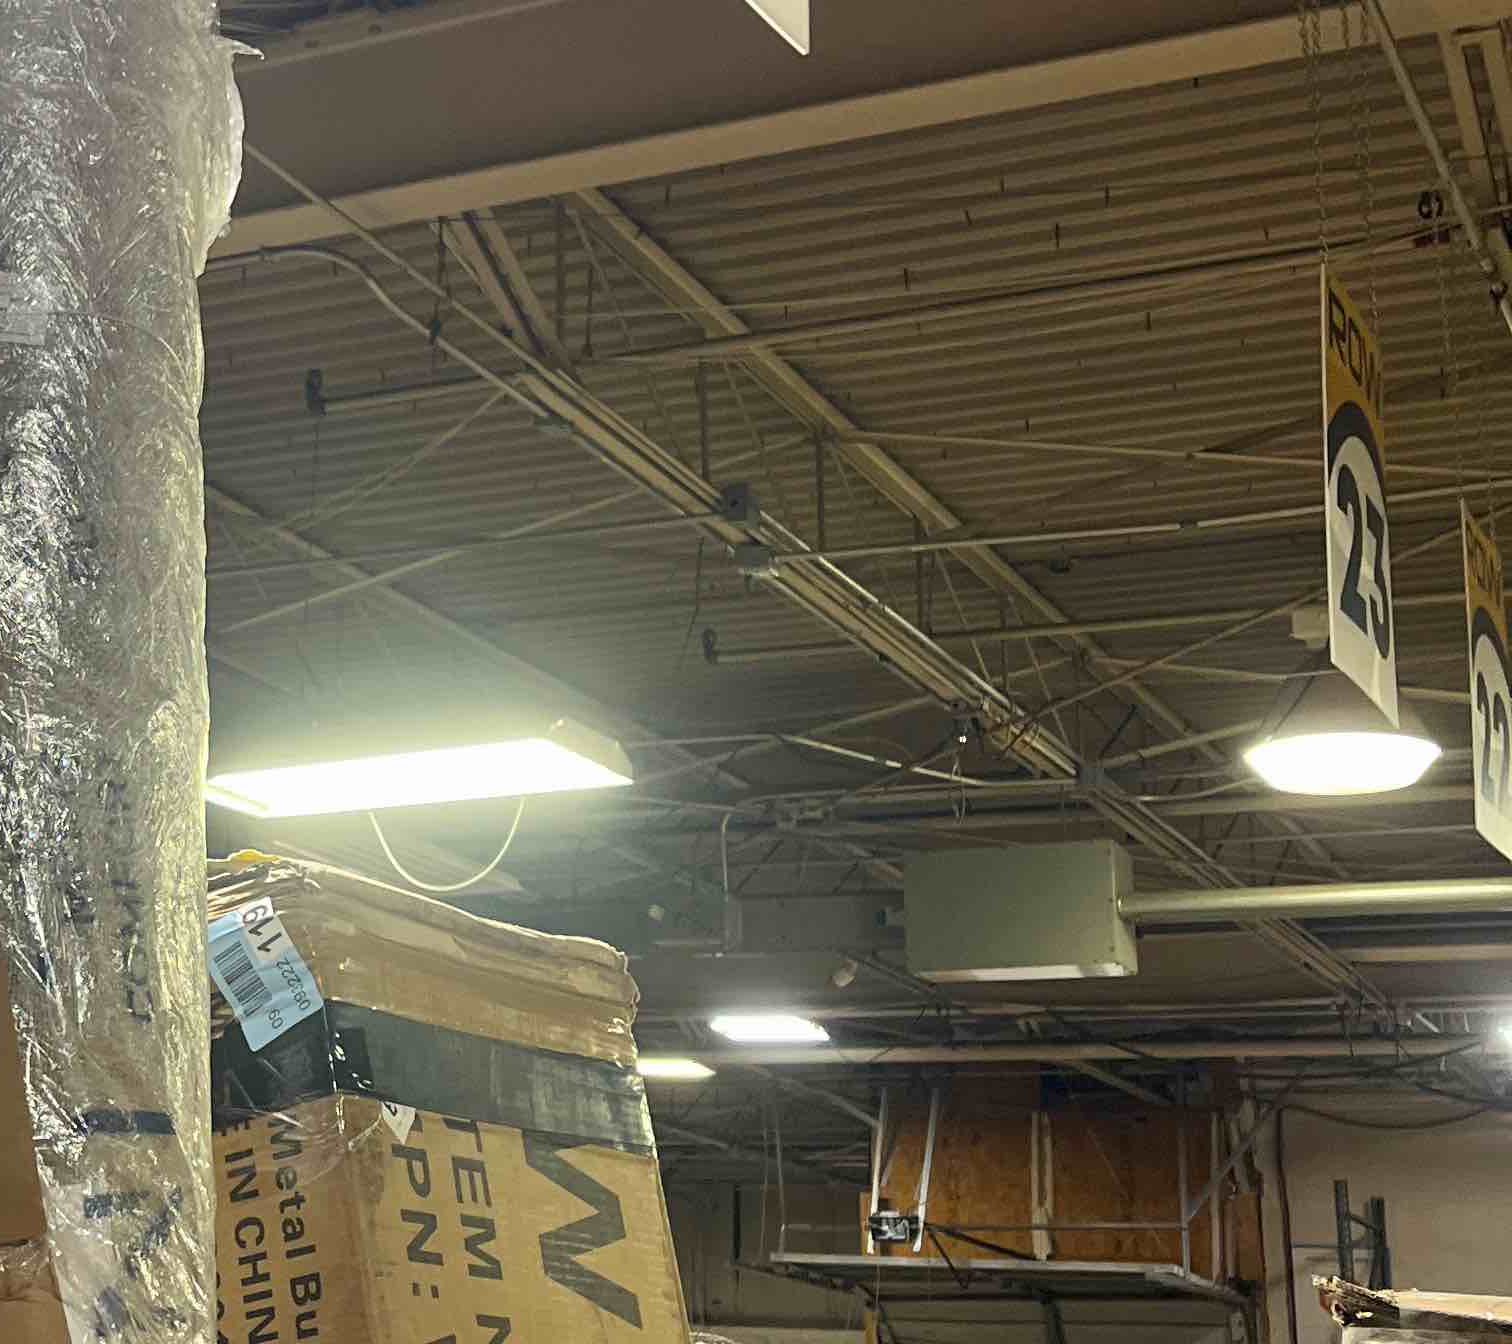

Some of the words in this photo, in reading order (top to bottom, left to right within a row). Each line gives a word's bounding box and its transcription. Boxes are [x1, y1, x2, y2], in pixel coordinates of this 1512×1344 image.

[1328, 287, 1383, 418] ROW
[1337, 463, 1390, 661] 23
[242, 905, 282, 953] 119
[225, 1148, 259, 1202] IN
[268, 1112, 316, 1260] Metal
[391, 1113, 445, 1299] PN:
